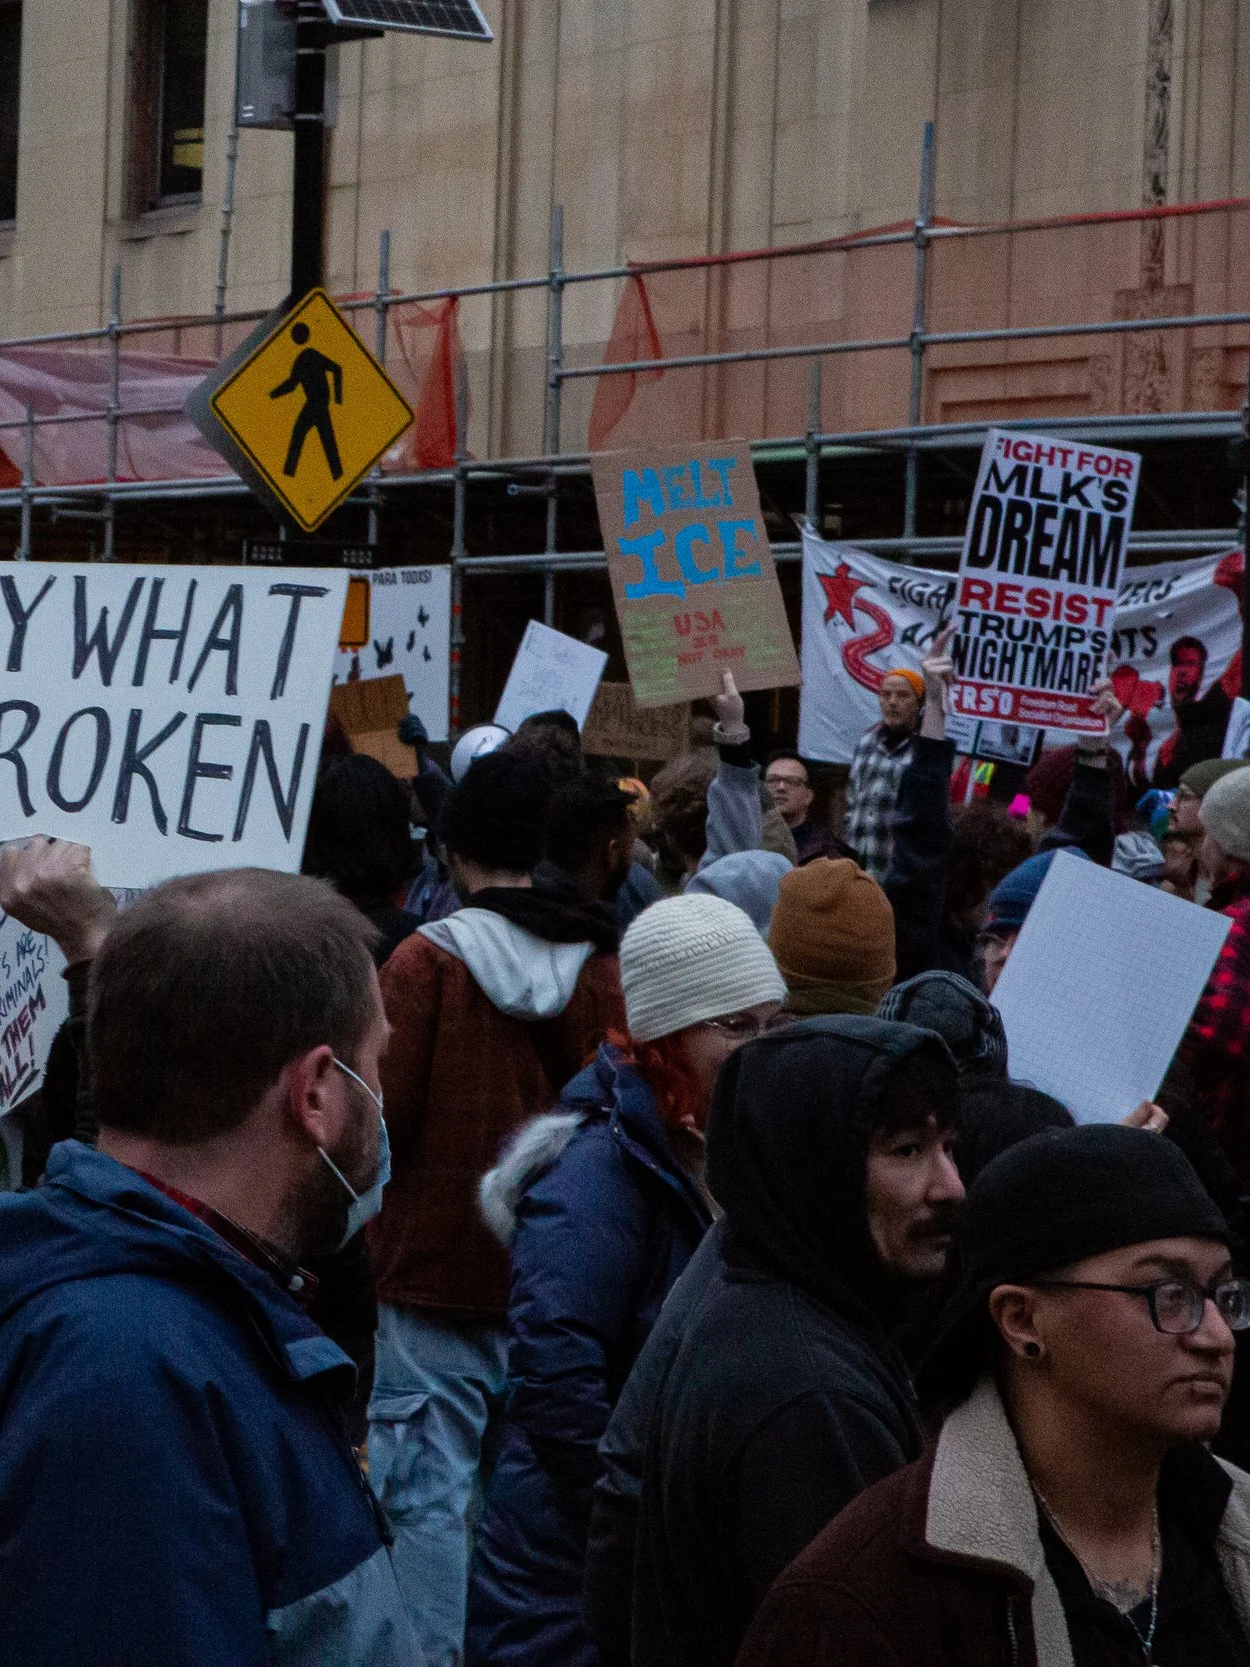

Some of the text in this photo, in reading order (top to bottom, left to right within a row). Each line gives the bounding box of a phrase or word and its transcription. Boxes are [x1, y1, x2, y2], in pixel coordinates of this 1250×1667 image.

[622, 456, 738, 529] MELT
[982, 459, 1129, 513] MLK'S
[1077, 452, 1134, 480] FOR
[617, 519, 762, 602] ICE
[966, 494, 1126, 590] DREAM
[674, 608, 726, 637] USA
[959, 577, 1114, 628] RESIST
[72, 575, 331, 700] WHAT
[958, 609, 1107, 654] TRUMP'S
[951, 634, 1103, 695] NIGHTMARE
